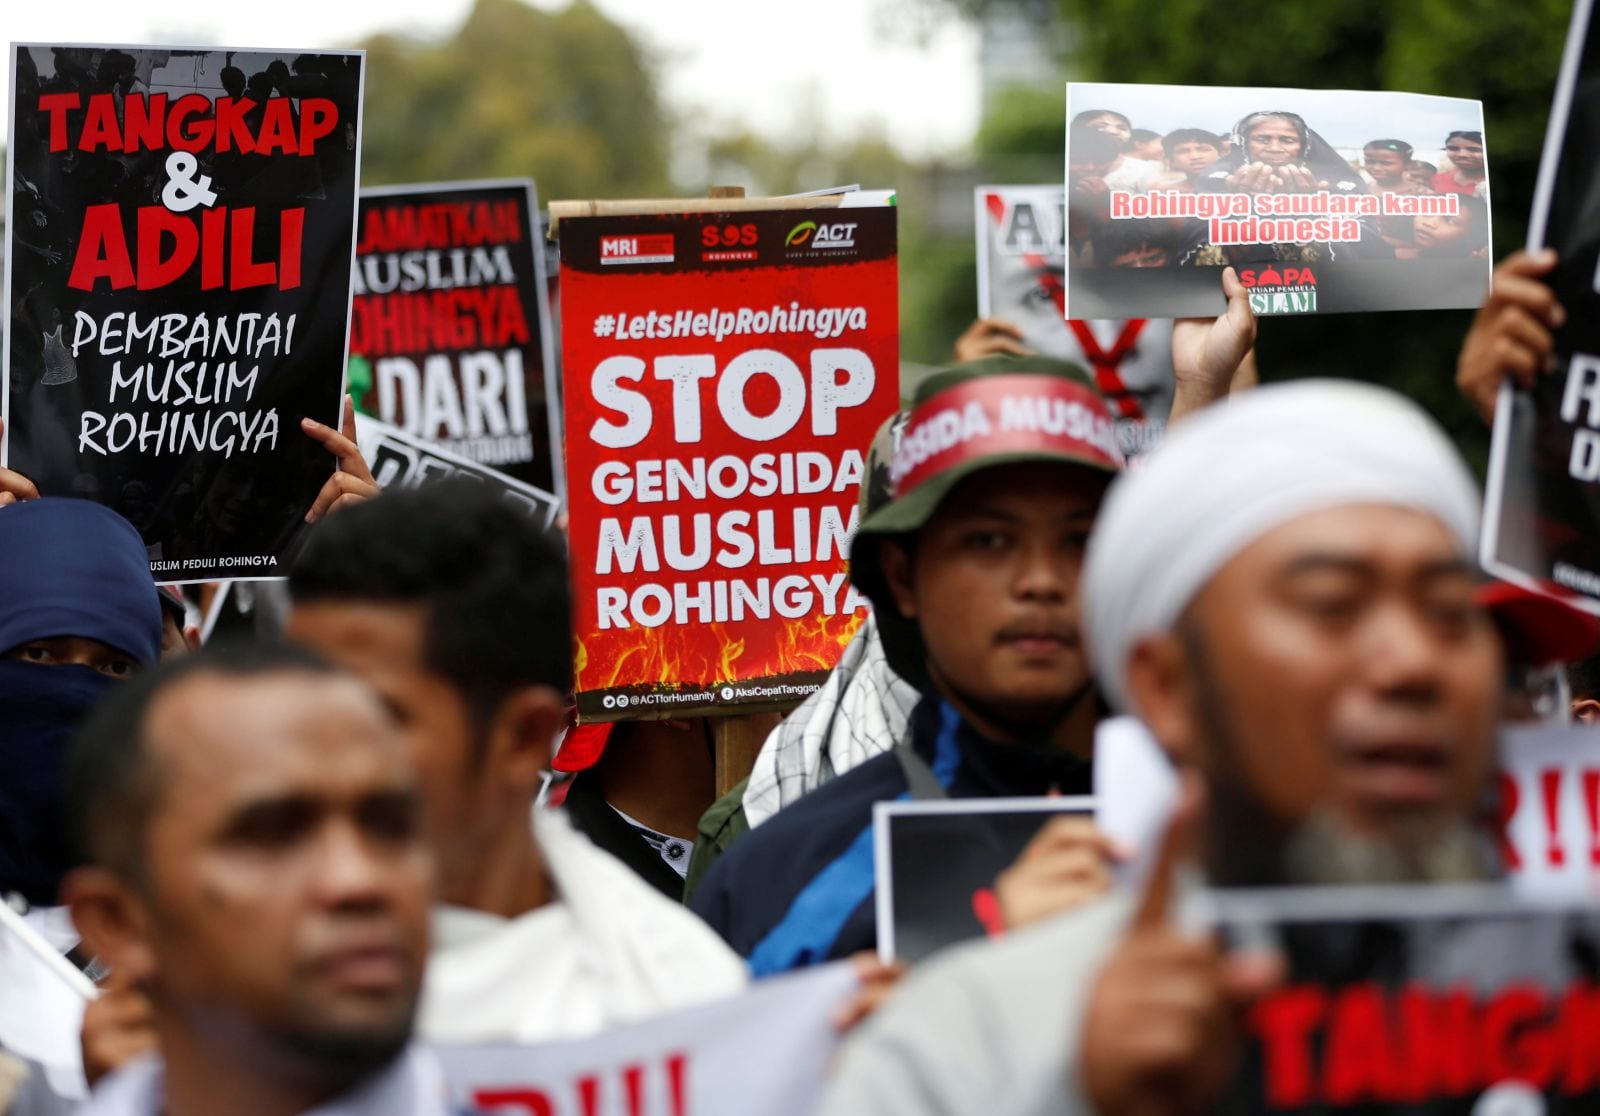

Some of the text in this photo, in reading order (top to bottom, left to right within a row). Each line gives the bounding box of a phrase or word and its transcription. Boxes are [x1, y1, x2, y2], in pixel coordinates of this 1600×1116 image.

[38, 92, 339, 156] TANGKAP
[162, 151, 218, 212] &
[1111, 191, 1460, 217] Rohingya saudara kami
[67, 203, 306, 292] ADILI
[357, 198, 520, 256] AMATKAN
[602, 239, 638, 256] MRI
[702, 224, 758, 246] SOS
[813, 223, 858, 241] ACT
[1208, 215, 1361, 245] Indonesia
[1247, 286, 1275, 294] ATUAN
[1249, 292, 1317, 314] SLAM
[72, 310, 297, 358] PEMBANTAI
[350, 286, 531, 355] OHINGYA
[593, 302, 867, 342] #LetsHelpRohingya
[109, 359, 259, 406] MUSLIM
[376, 349, 527, 441] DARI
[590, 348, 876, 449] STOP
[79, 408, 279, 459] ROHINGYA
[890, 402, 990, 482] OSIDA
[591, 449, 865, 505] GENOSIDA
[149, 555, 278, 571] USLIM PEDULI ROHINGYA
[596, 505, 863, 574] MUSLIM
[596, 573, 871, 630] ROHINGYA
[630, 692, 715, 706] @ACTforHumanity
